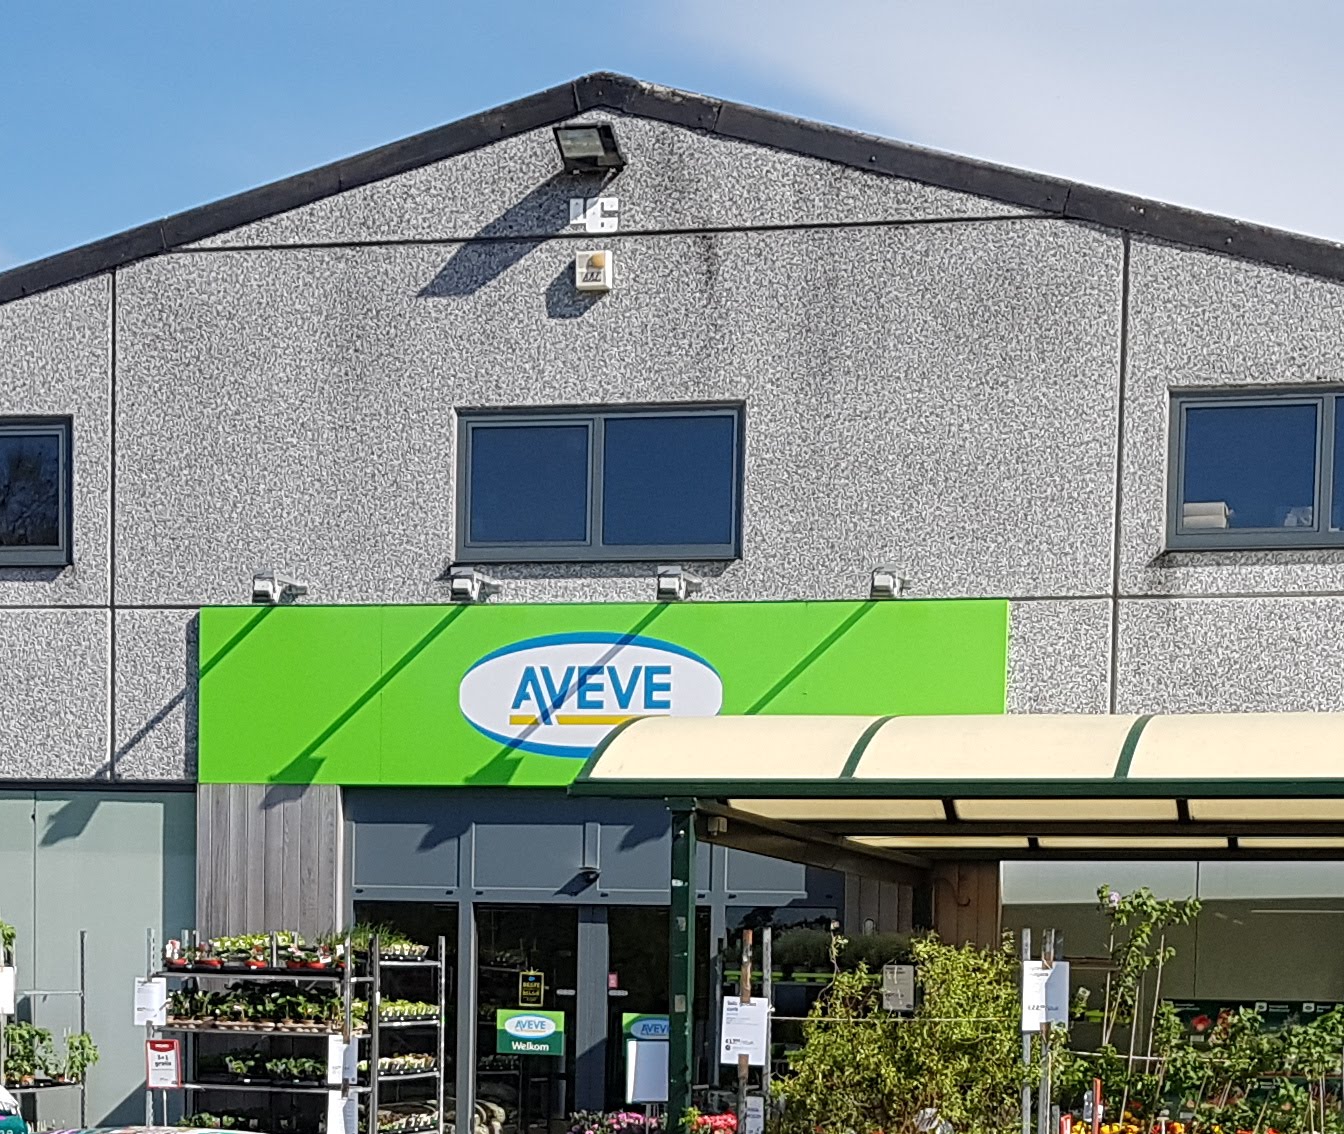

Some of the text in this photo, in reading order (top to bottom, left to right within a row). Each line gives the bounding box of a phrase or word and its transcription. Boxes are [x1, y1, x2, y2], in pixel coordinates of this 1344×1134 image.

[511, 665, 672, 725] AVEVE
[514, 1020, 547, 1031] AVEVE
[511, 1040, 549, 1052] Welkom
